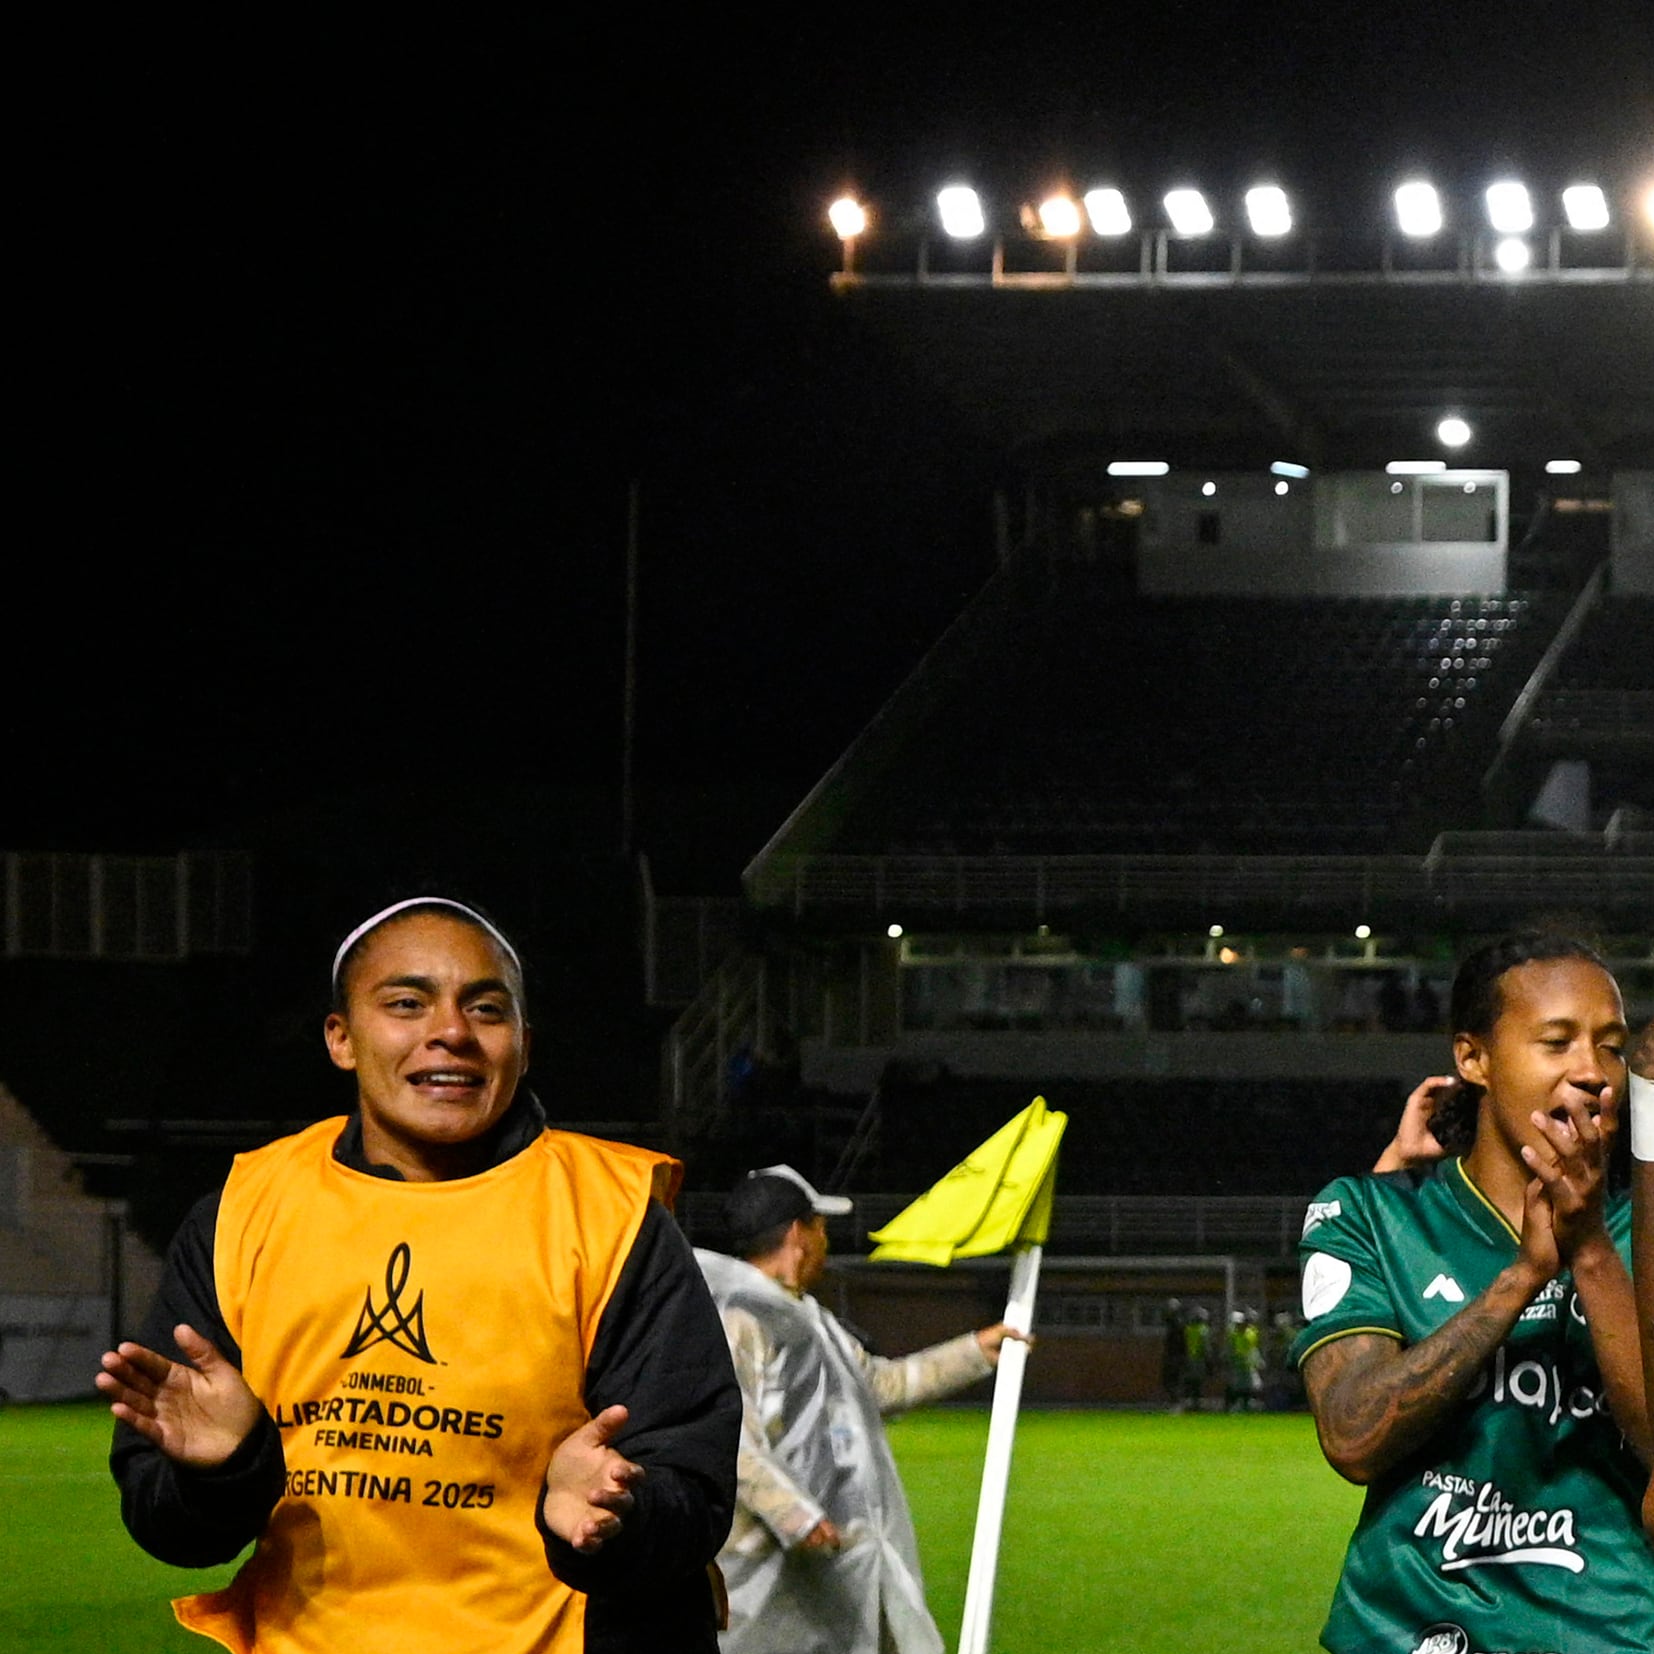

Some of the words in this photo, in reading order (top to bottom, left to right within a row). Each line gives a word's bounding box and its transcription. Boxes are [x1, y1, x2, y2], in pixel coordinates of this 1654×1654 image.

[1519, 1303, 1557, 1321] zza
[314, 1430, 433, 1457] FEMENINA
[284, 1469, 411, 1503] RGENTINA
[422, 1480, 495, 1509] 2025
[1423, 1471, 1476, 1497] PASTAS
[1477, 1482, 1502, 1513] La
[1414, 1493, 1575, 1560] Muñeca
